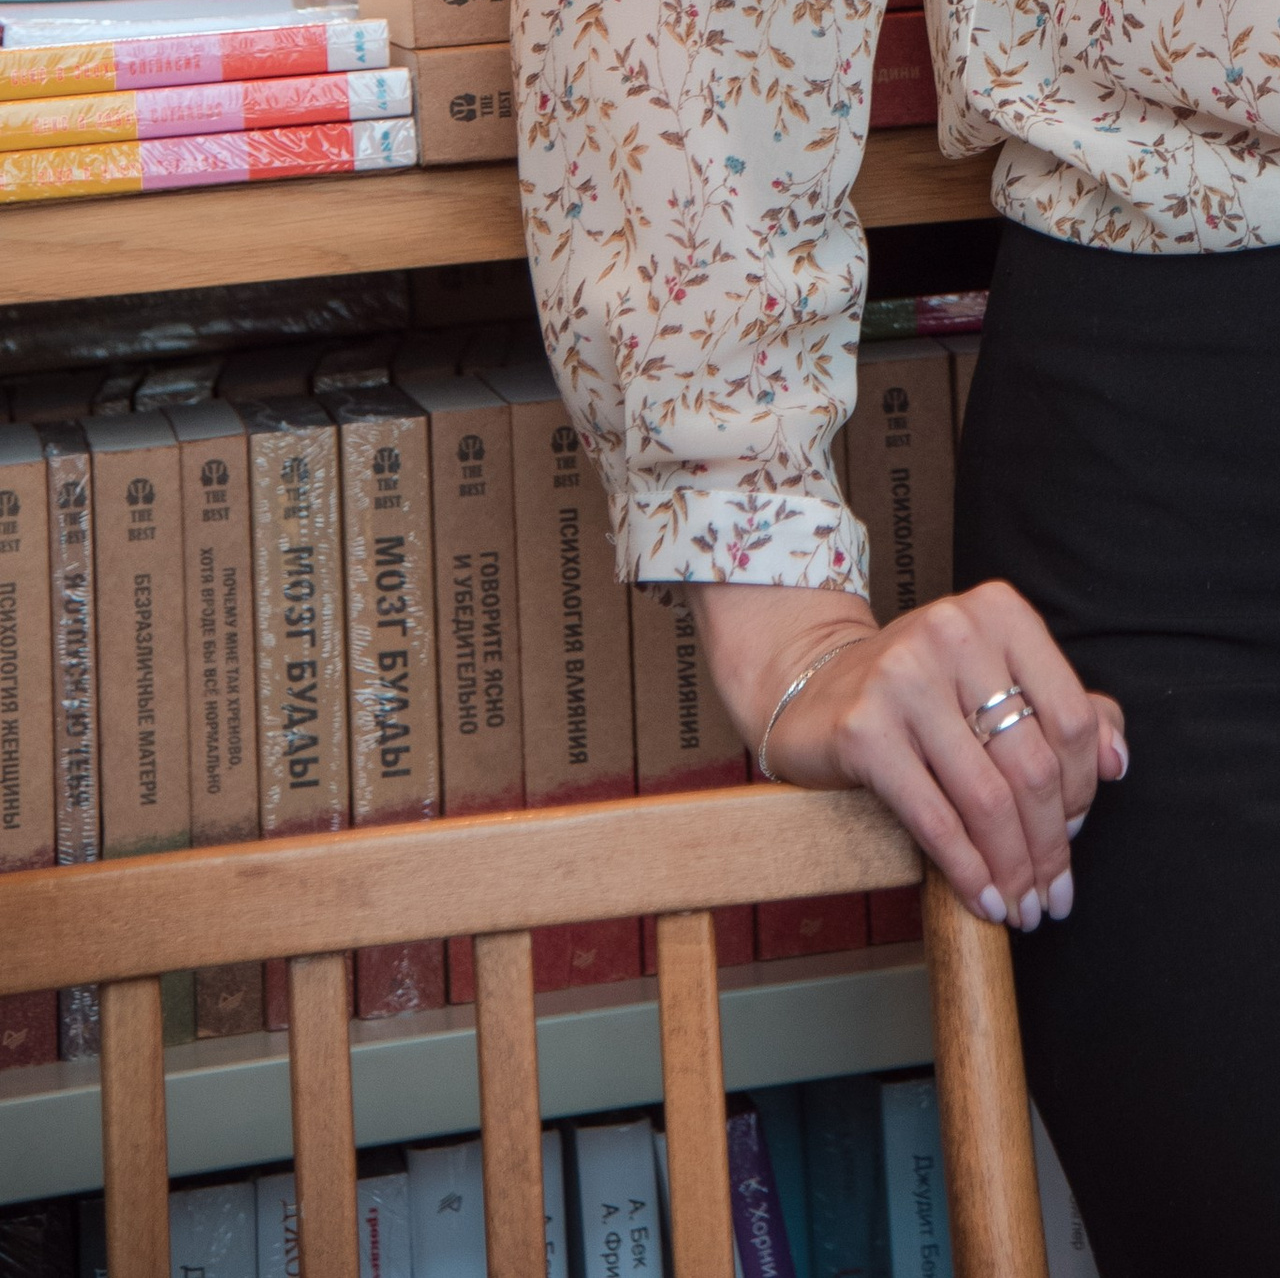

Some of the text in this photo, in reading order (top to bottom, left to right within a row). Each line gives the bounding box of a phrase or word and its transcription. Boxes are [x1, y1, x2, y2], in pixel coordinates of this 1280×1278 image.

[480, 93, 494, 117] THE
[498, 90, 512, 118] BEST
[461, 465, 483, 479] THE
[553, 474, 580, 489] BEST
[555, 457, 577, 471] THE
[206, 490, 228, 504] THE
[374, 494, 402, 509] BEST
[459, 482, 487, 497] BEST
[131, 508, 153, 523] THE
[202, 508, 230, 522] BEST
[128, 526, 156, 541] BEST
[890, 468, 917, 611] ПСИХОЛОГИЯ
[199, 547, 216, 585] ХОТЯ
[200, 588, 217, 638] ВРОДЕ
[222, 567, 238, 628] ПОЧЕМУ
[202, 641, 218, 666] БЫ
[224, 632, 240, 665] МНЕ
[451, 554, 477, 736] И УБЕДИТЕЛЬНО
[480, 551, 506, 729] ГОВОРИТЕ ЯСНО
[557, 508, 589, 766] ПСИХОЛОГИЯ ВЛИЯНИЯ
[281, 544, 320, 790] МОЗГ БУДДЫ
[374, 536, 412, 779] МОЗГ БУДДЫ
[134, 573, 157, 806] БЕЗРАЗЛИЧНЫЕ МАТЕРИ
[225, 668, 241, 696] ТАК
[677, 644, 700, 750] ВЛИЯНИЯ
[0, 582, 21, 830] ПСИХОЛОГИЯ ЖЕНЩИНЫ
[204, 700, 221, 795] НОРМАЛЬНО
[912, 1155, 935, 1237] Джудит
[601, 1203, 620, 1225] А.
[628, 1199, 649, 1269] А. Бек
